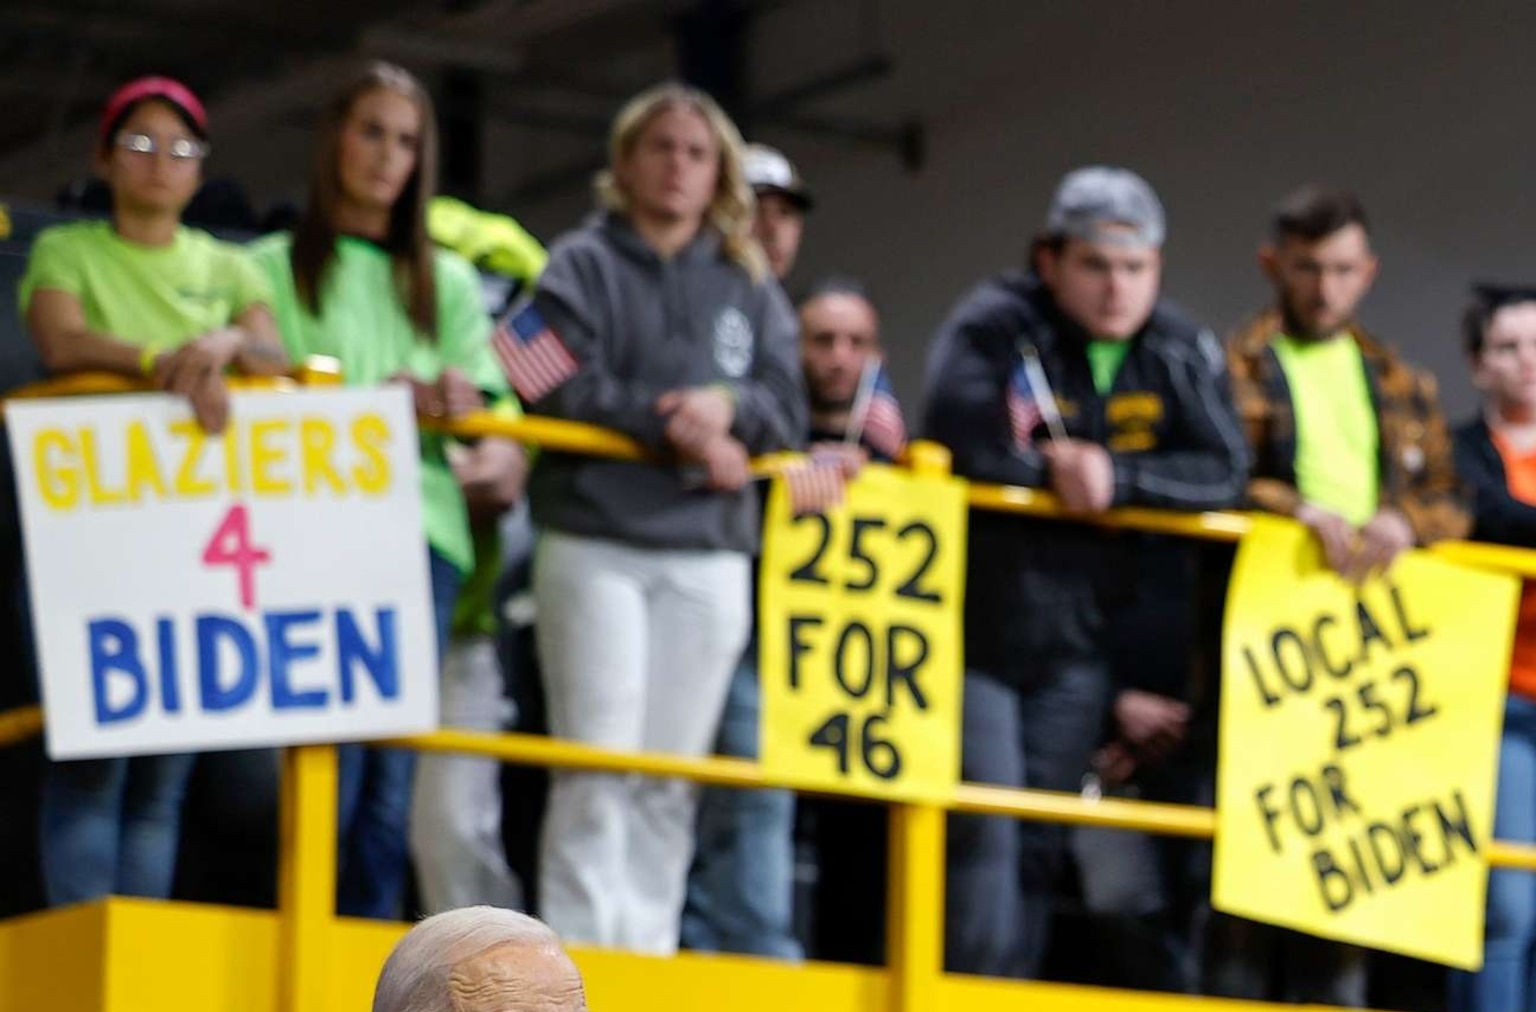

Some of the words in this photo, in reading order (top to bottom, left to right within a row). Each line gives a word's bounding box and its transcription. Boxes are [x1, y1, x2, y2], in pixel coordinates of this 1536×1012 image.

[32, 413, 392, 513] GLAZIERS
[202, 502, 271, 611] 4
[789, 512, 943, 603] 252
[87, 607, 401, 726] BIDEN
[789, 616, 928, 709] FOR
[1243, 587, 1430, 706] LOCAL
[809, 713, 903, 780] 46
[1325, 666, 1438, 751] 252
[1255, 765, 1362, 854] FOR
[1310, 792, 1480, 914] BIDEN
